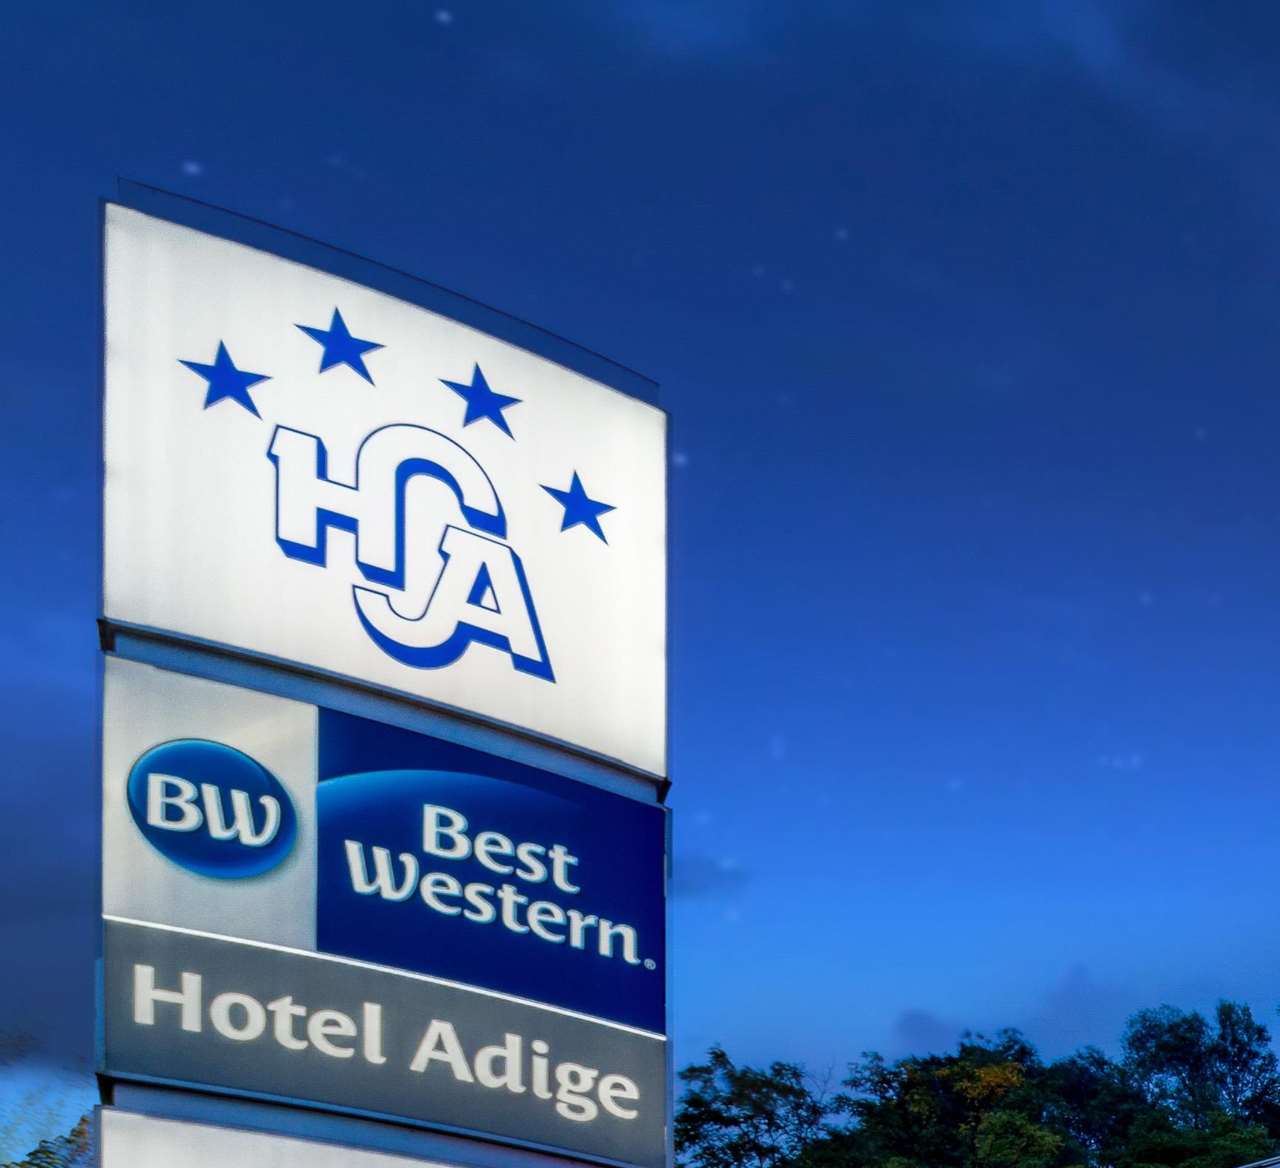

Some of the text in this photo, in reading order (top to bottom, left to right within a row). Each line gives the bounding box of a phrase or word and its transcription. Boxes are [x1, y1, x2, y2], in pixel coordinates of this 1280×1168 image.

[146, 772, 281, 847] BW
[422, 803, 580, 894] Best
[132, 964, 640, 1122] Hotel Adige
